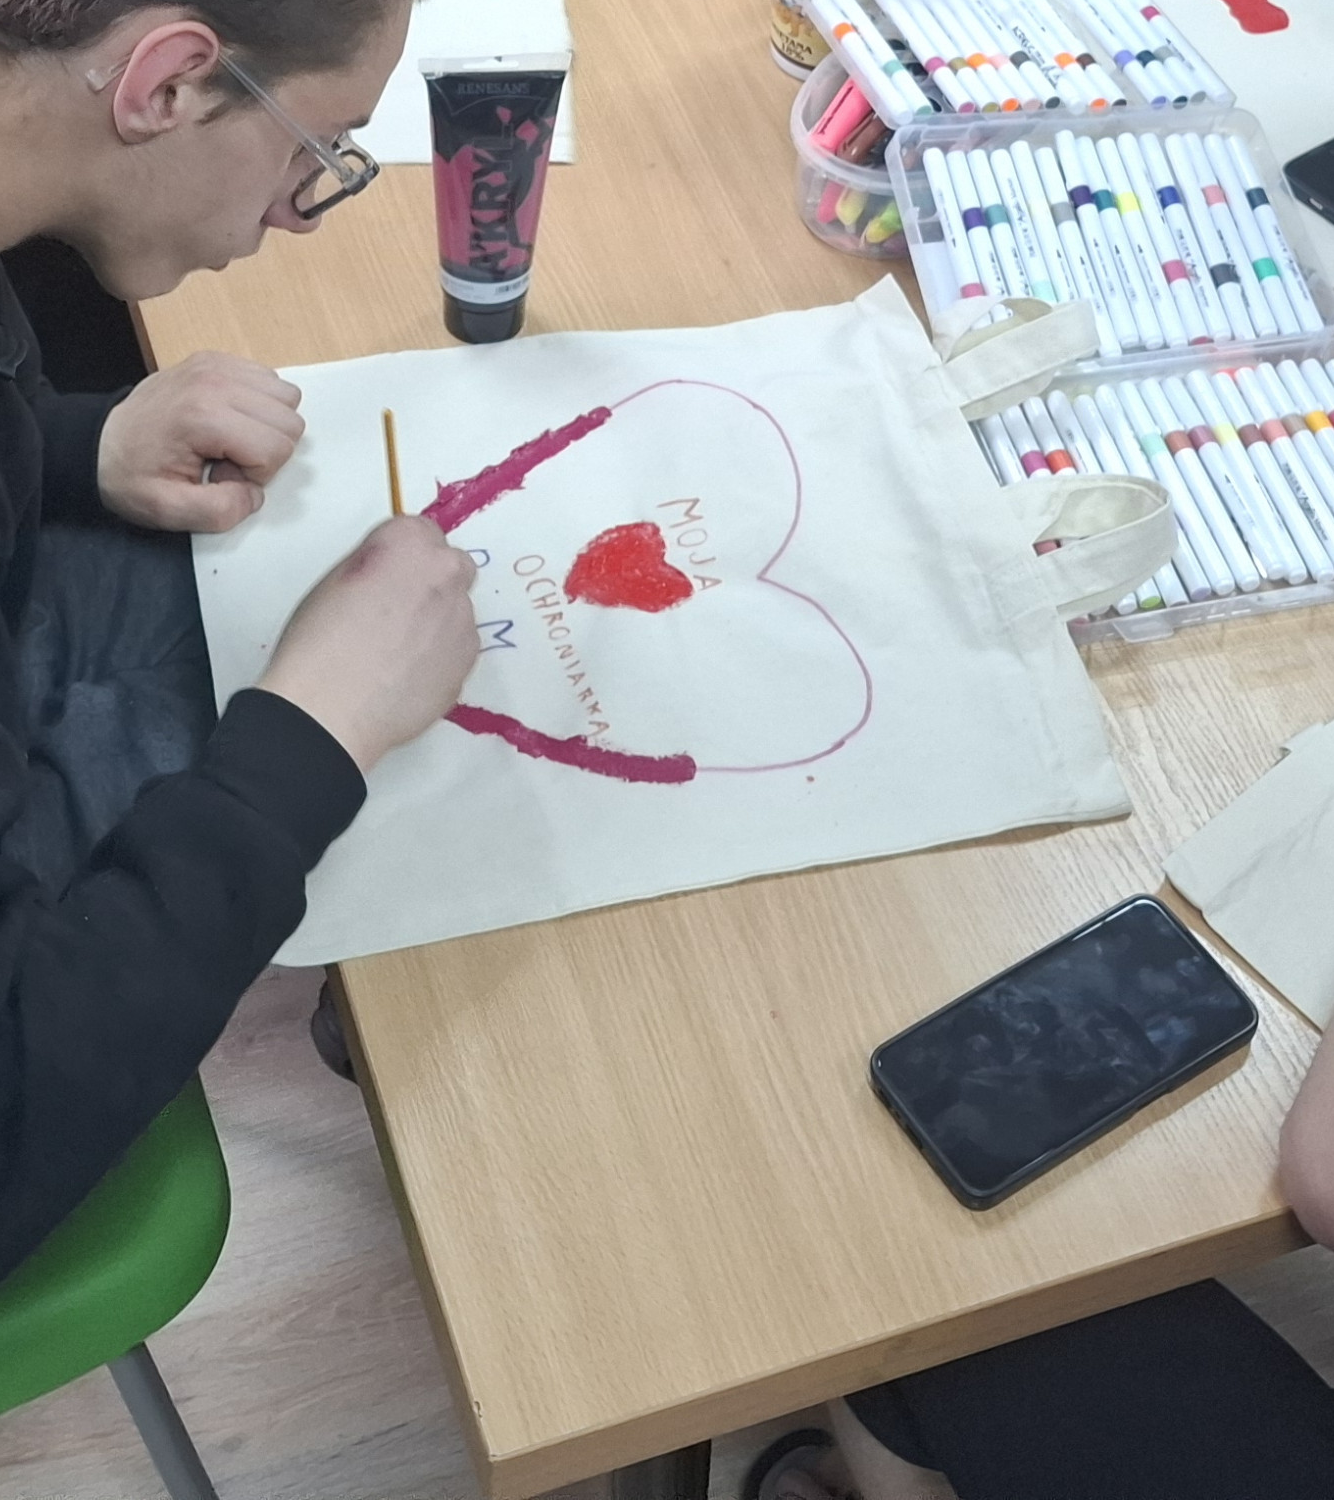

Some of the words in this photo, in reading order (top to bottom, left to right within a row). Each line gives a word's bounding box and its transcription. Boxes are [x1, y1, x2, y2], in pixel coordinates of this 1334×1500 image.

[456, 81, 531, 95] RENESANS
[655, 496, 723, 593] MOJA
[511, 553, 611, 738] OCHRONIARKA
